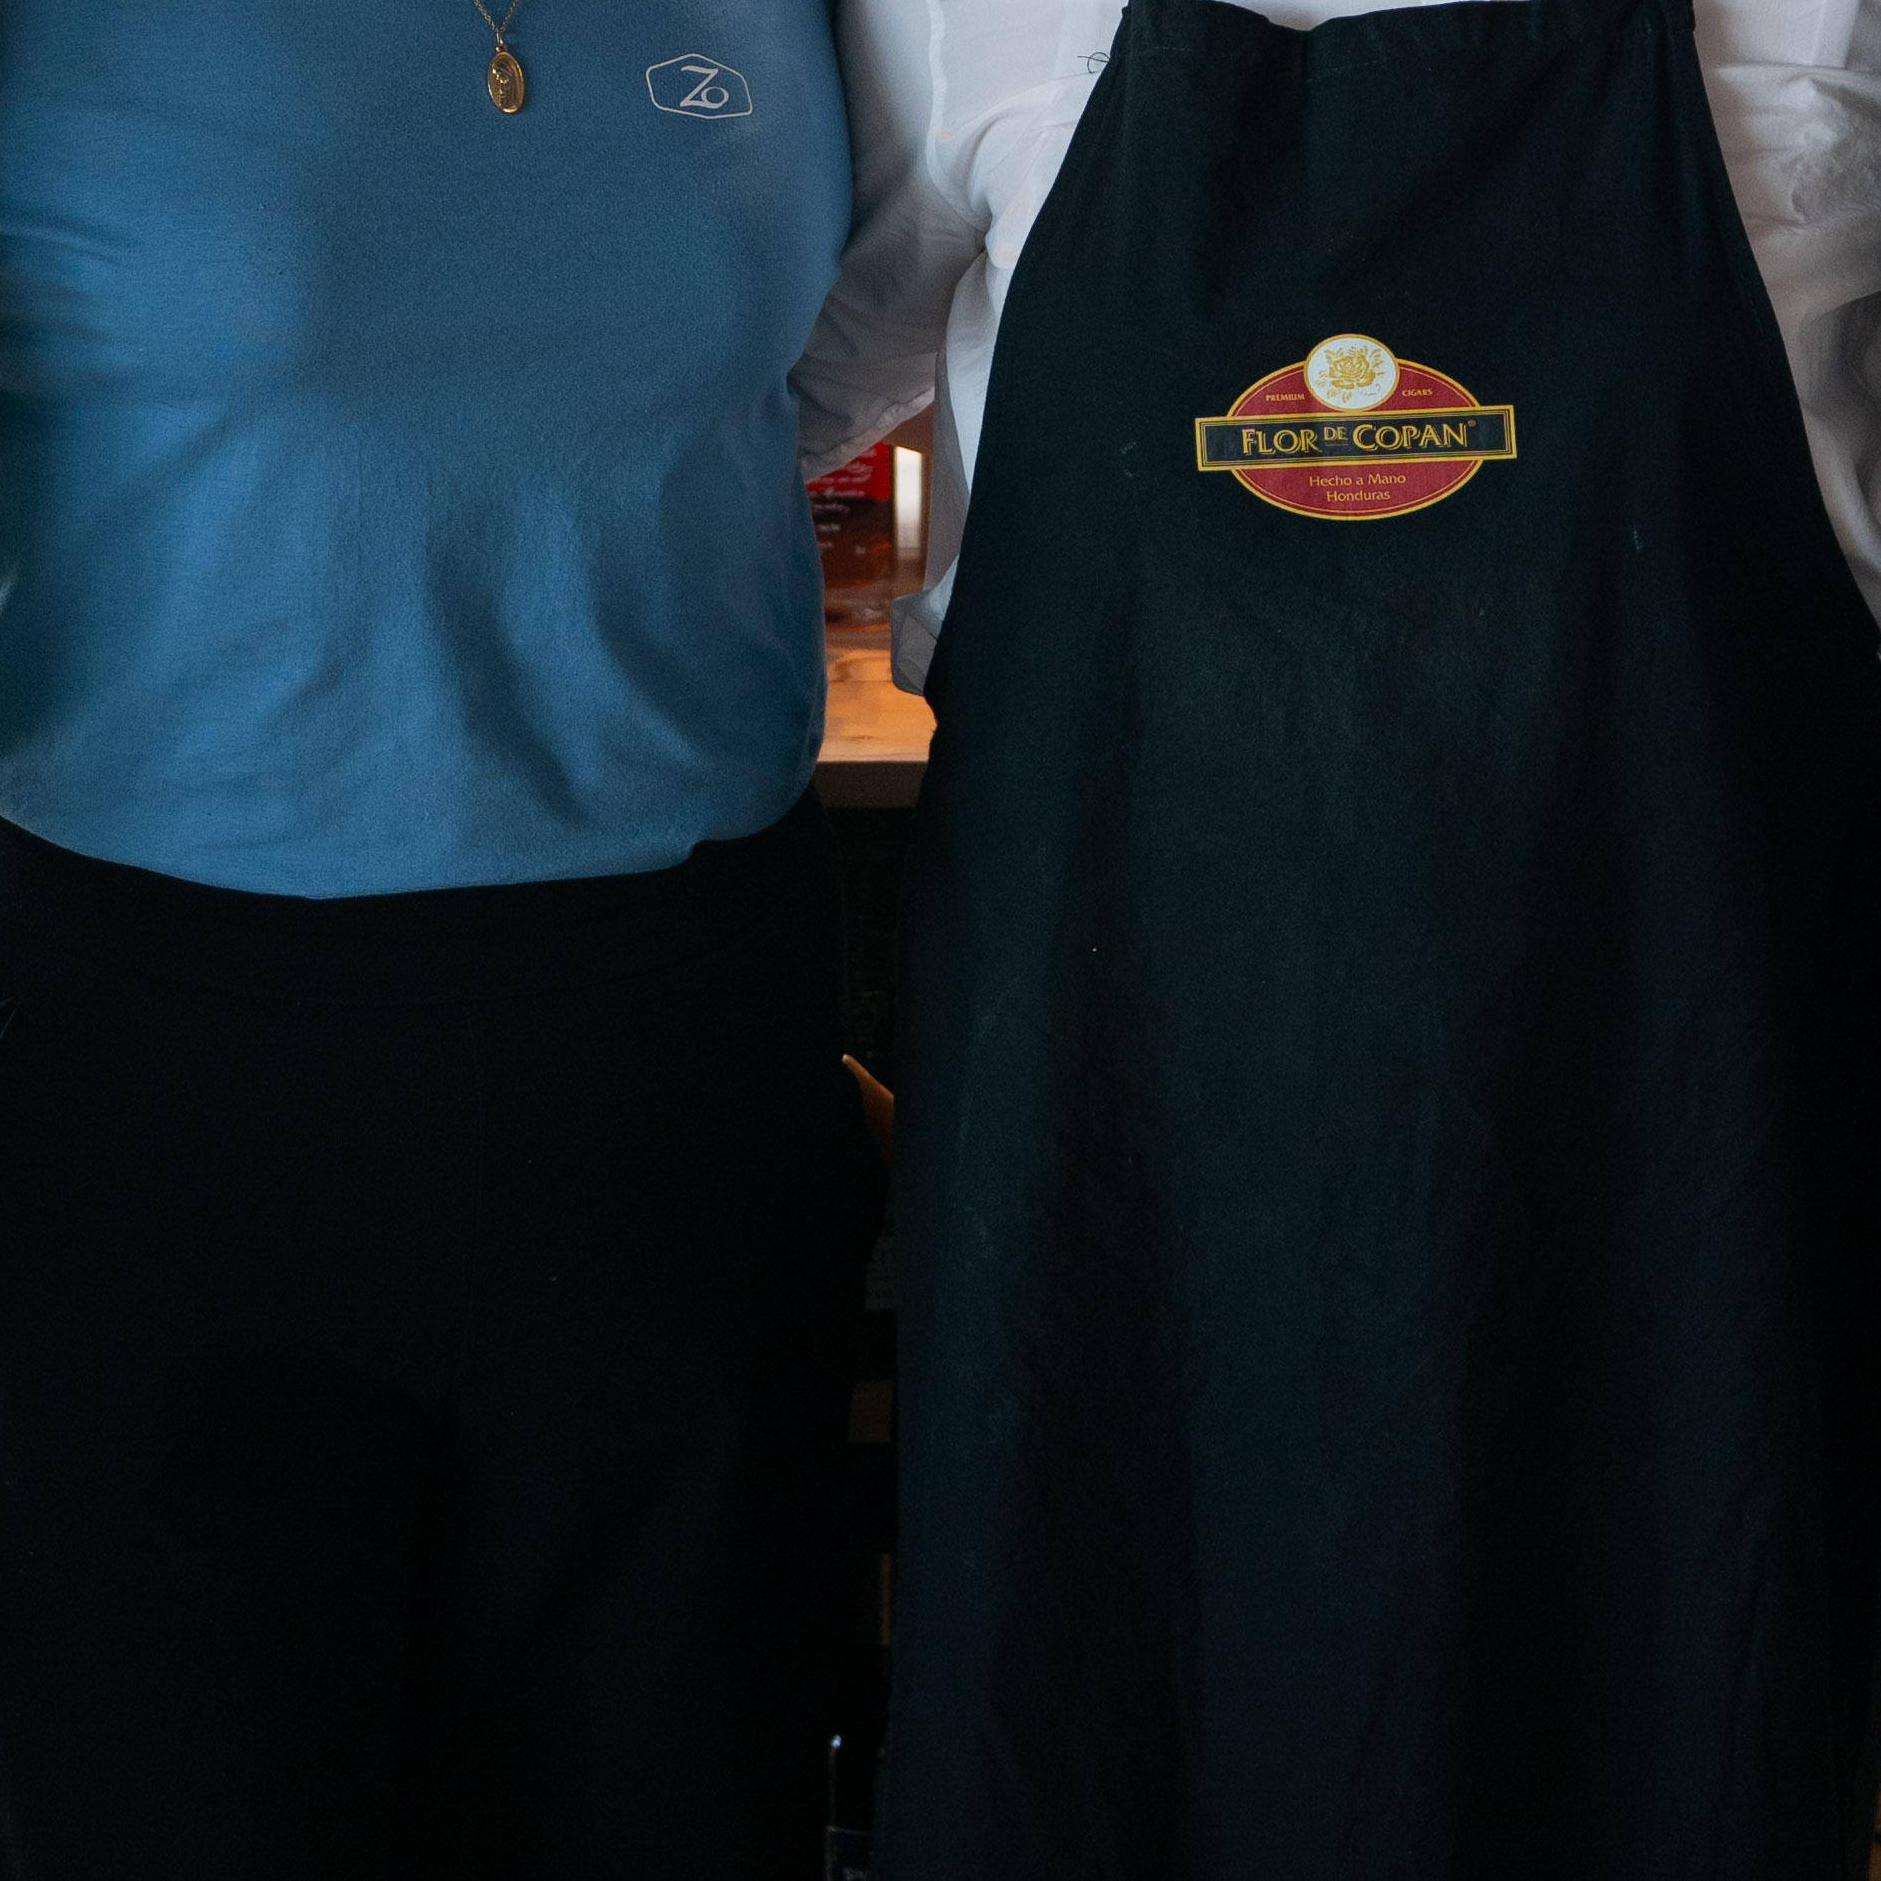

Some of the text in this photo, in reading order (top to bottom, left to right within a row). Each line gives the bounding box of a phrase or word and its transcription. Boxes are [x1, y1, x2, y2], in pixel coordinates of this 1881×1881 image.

[1265, 388, 1433, 402] PREMIUM CIGARS
[1240, 428, 1321, 455] FLOR
[1324, 425, 1348, 441] DE
[1308, 472, 1407, 487] Hecho a Mano
[1326, 490, 1391, 502] Honduras
